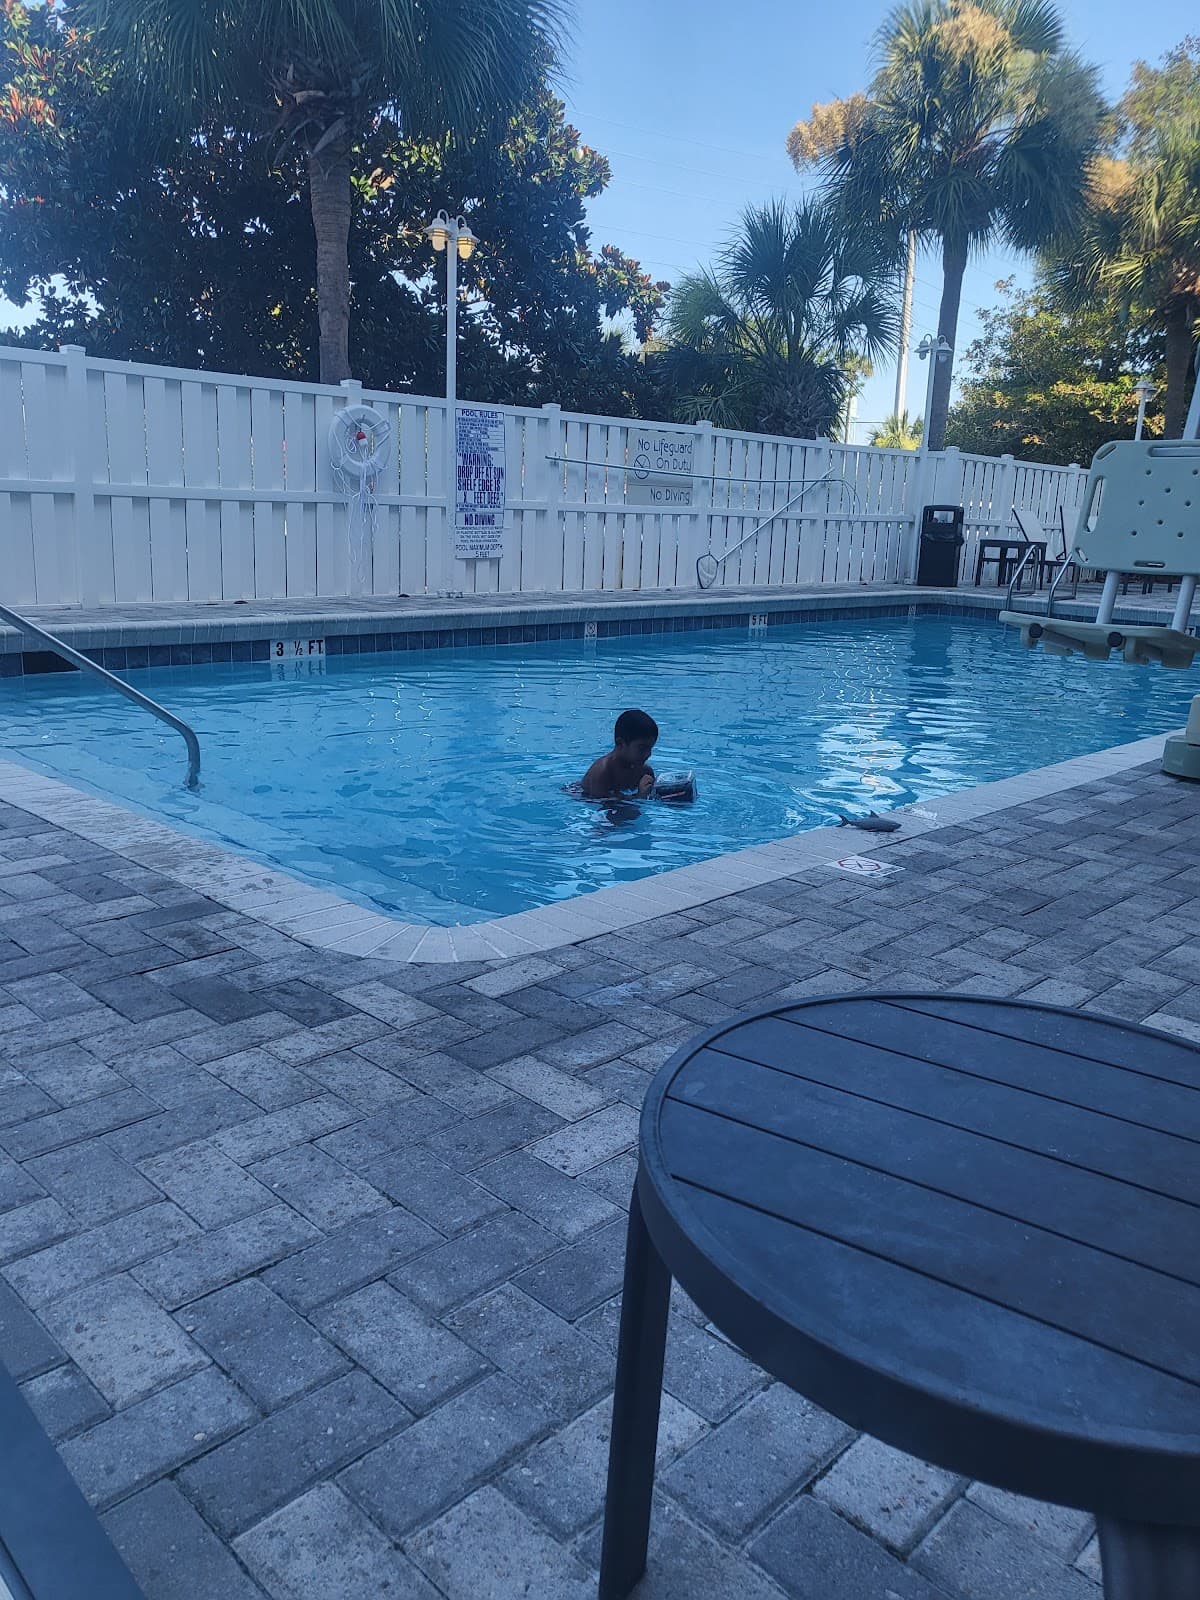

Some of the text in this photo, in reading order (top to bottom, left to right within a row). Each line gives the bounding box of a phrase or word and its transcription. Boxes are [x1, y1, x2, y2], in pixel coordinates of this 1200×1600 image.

[461, 409, 498, 419] POOL RULES
[637, 438, 692, 456] No Lifeguard
[457, 465, 504, 480] DROP OFF AT SUN
[656, 457, 691, 474] On Duty
[457, 478, 501, 492] SHELF EDGE IS
[474, 491, 487, 504] FEET
[650, 487, 690, 506] No Diving
[464, 512, 496, 526] NO DIVING
[276, 641, 284, 657] 3
